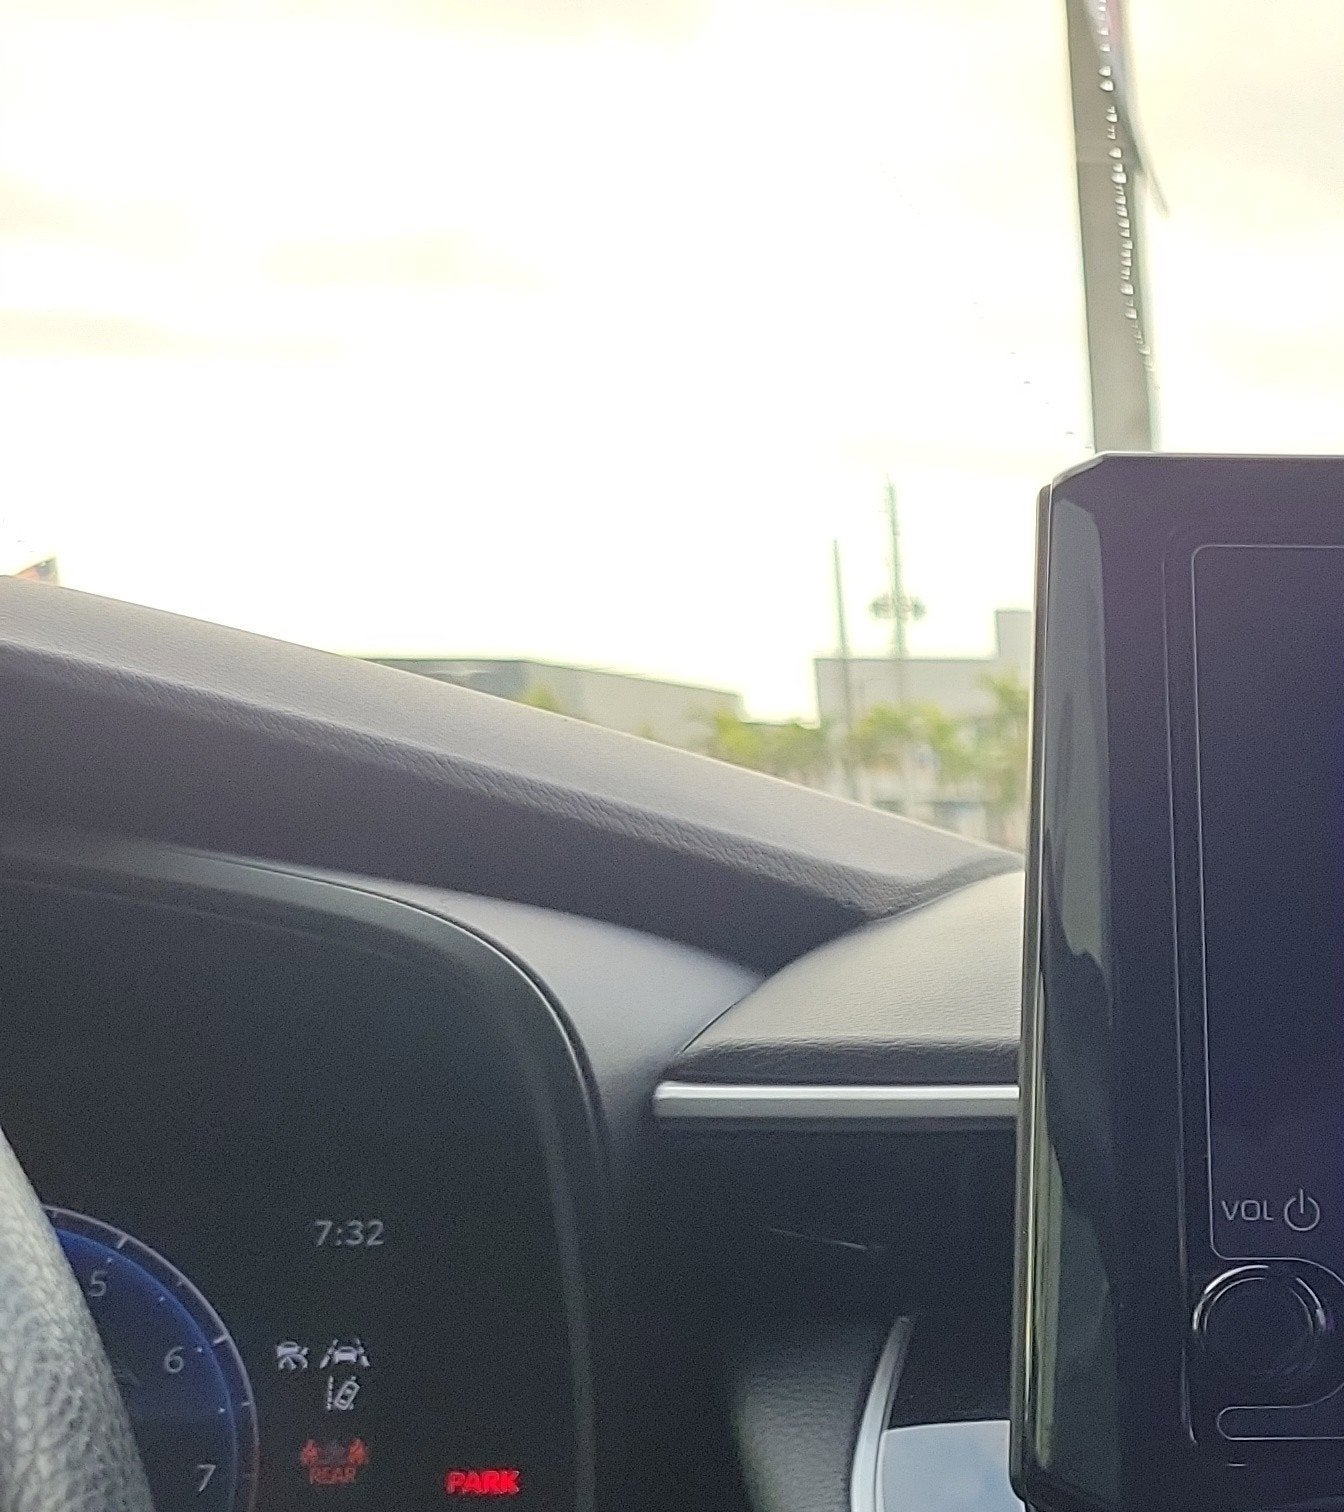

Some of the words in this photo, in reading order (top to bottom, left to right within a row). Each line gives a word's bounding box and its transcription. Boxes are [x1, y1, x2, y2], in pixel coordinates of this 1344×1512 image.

[1221, 1199, 1274, 1221] VOL
[314, 1219, 385, 1246] 7:32
[88, 1270, 108, 1298] 5
[164, 1347, 184, 1373] 6
[196, 1464, 216, 1493] 7
[447, 1470, 520, 1494] PARK
